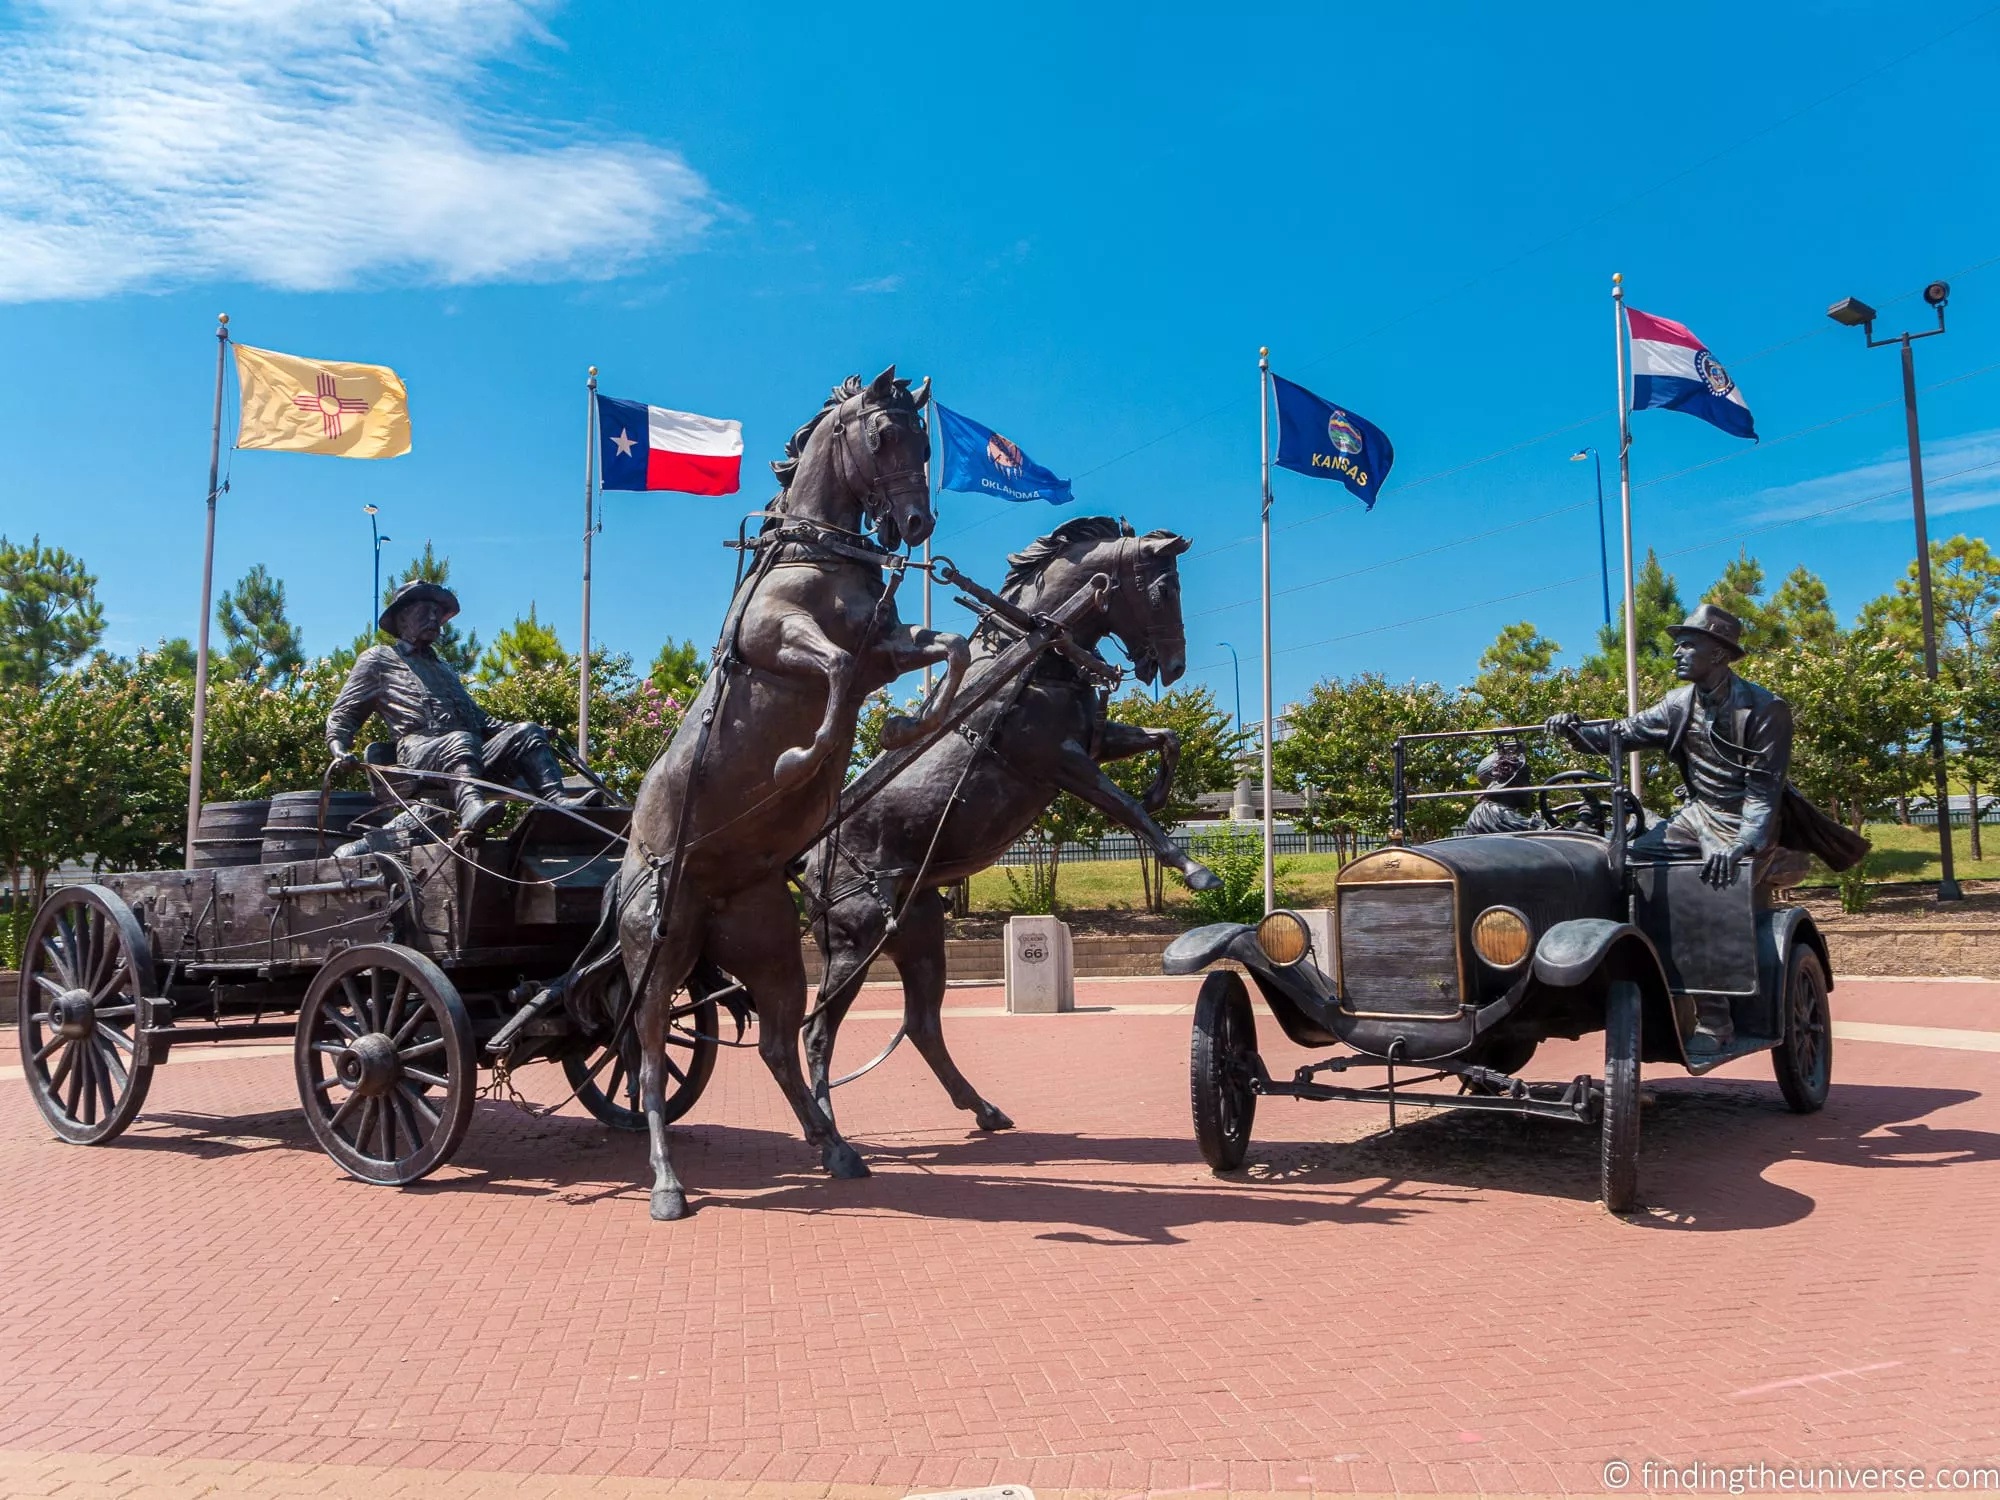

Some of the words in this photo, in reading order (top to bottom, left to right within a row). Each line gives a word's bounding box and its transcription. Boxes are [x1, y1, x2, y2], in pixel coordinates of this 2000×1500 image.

[1312, 453, 1367, 486] KANSAS
[981, 478, 1040, 499] OKLAHOMA
[1024, 948, 1042, 958] 66
